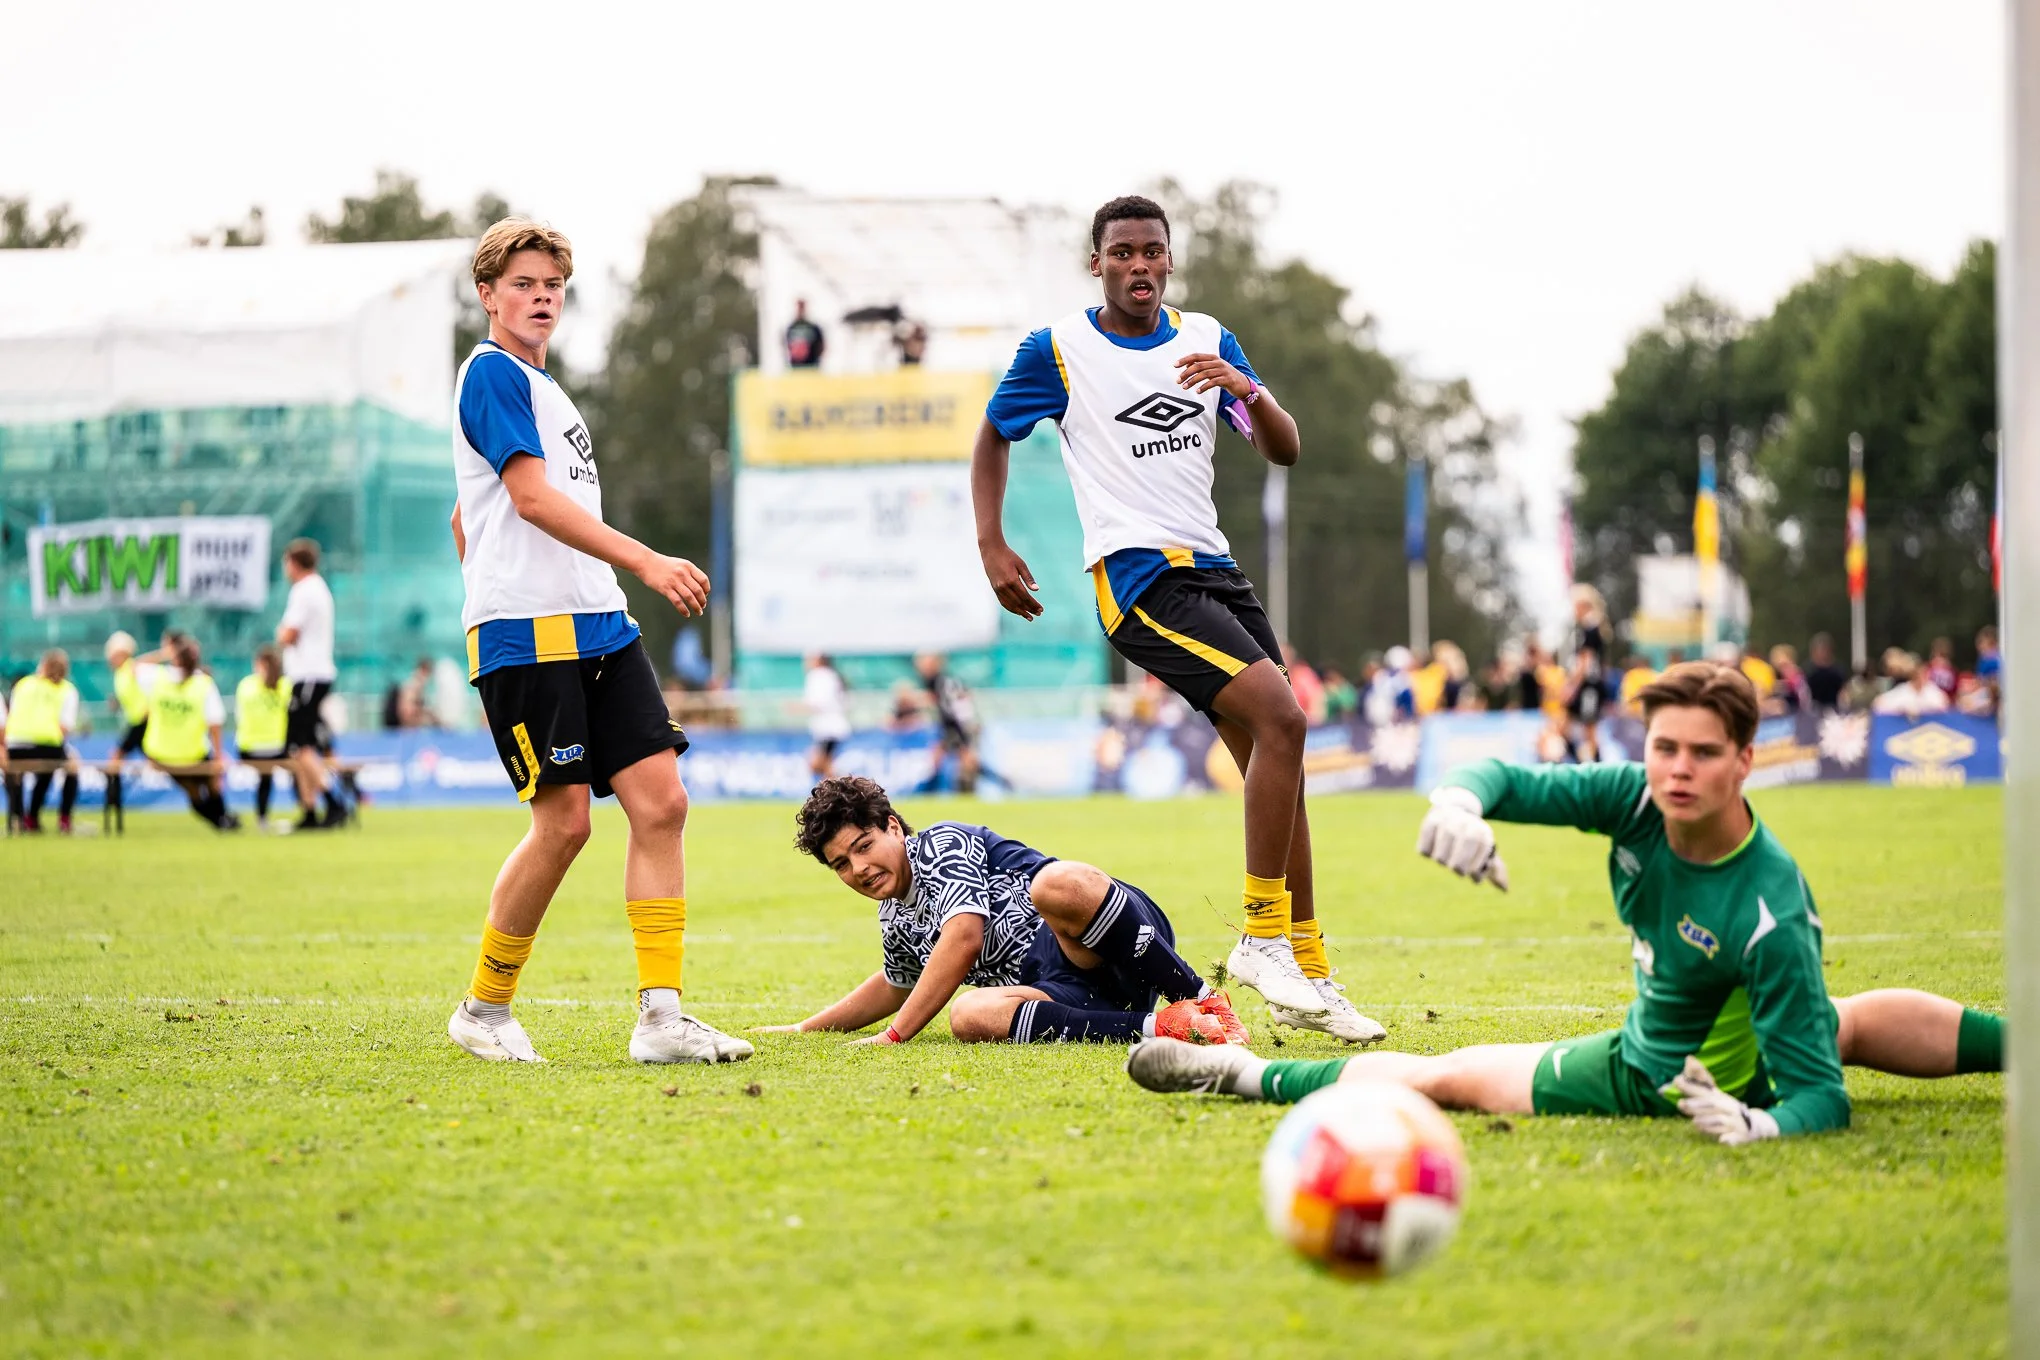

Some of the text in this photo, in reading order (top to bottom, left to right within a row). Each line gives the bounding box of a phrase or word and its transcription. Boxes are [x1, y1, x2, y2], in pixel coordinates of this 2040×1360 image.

[1131, 433, 1202, 459] umbro
[569, 465, 599, 486] umbr
[44, 534, 179, 597] KIWI
[510, 755, 526, 782] umbro
[1246, 908, 1274, 917] umbro
[483, 961, 514, 977] umbro
